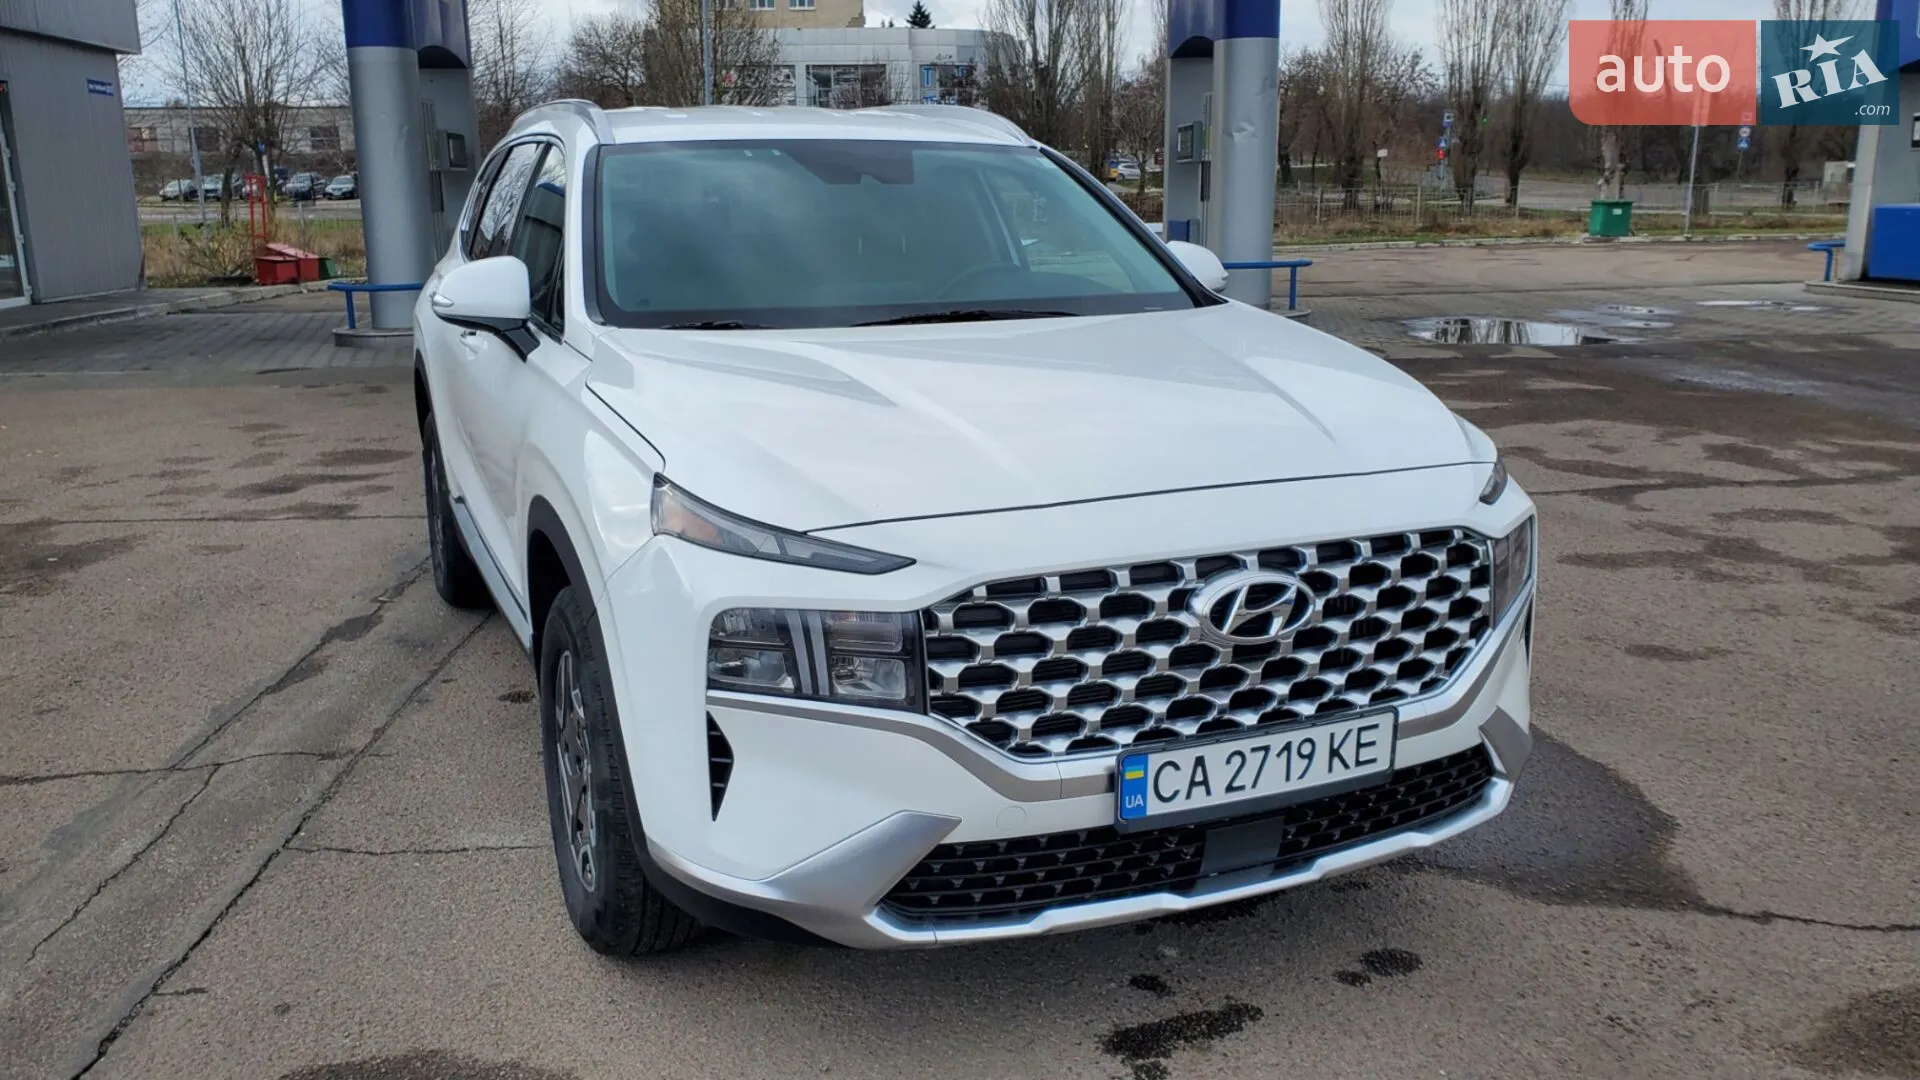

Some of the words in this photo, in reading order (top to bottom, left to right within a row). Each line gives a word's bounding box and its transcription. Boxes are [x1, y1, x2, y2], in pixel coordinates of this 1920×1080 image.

[1153, 755, 1212, 804] CA
[1224, 737, 1317, 795] 2719
[1327, 723, 1380, 774] KE
[1125, 794, 1144, 809] UA
